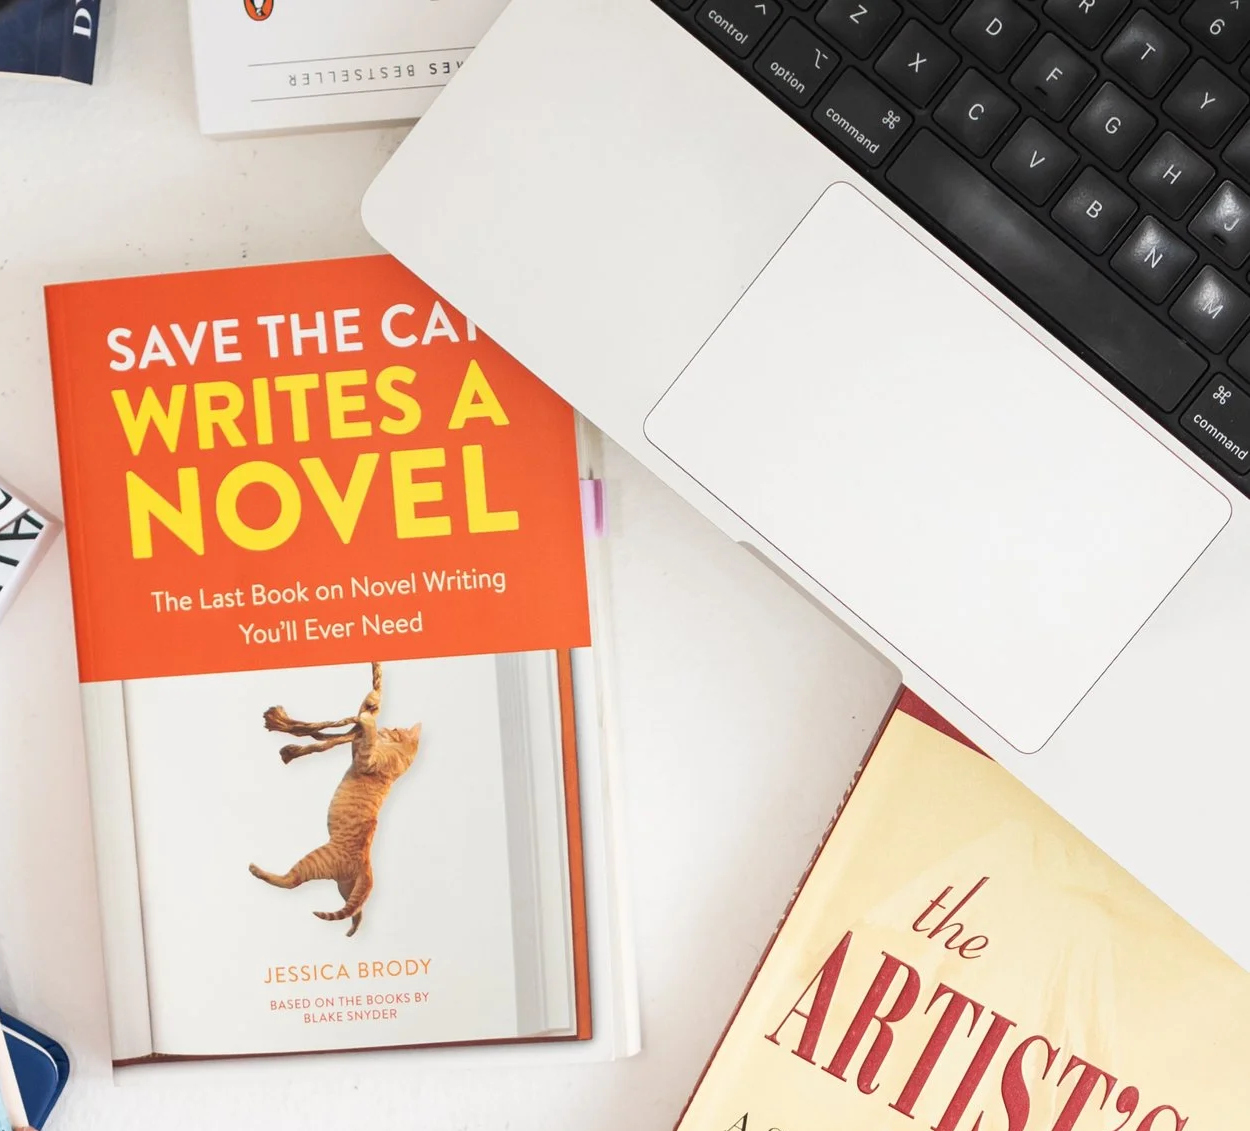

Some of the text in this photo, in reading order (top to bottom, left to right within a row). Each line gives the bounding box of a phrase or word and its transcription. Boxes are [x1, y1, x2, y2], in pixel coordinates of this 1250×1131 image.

[849, 4, 868, 25] Z
[708, 8, 749, 45] control
[985, 17, 1003, 36] D
[1209, 18, 1226, 35] 6
[1140, 42, 1156, 60] T
[907, 52, 928, 73] X
[288, 64, 415, 87] BESTSELLER
[770, 61, 806, 94] option
[1045, 66, 1063, 82] F
[1200, 91, 1216, 110] Y
[968, 103, 985, 121] C
[825, 107, 880, 155] command
[1104, 116, 1122, 135] G
[1029, 150, 1046, 169] V
[1162, 164, 1182, 185] H
[1086, 199, 1104, 221] B
[1144, 247, 1163, 269] N
[1201, 298, 1224, 320] M
[106, 318, 242, 372] SAVE
[258, 307, 364, 358] THE
[111, 359, 510, 457] WRITES A
[1193, 412, 1250, 461] command
[125, 444, 520, 560] NOVEL
[151, 567, 507, 614] The Last Book on Novel Writing
[238, 611, 423, 646] You'll Ever Need
[912, 875, 991, 960] the
[263, 958, 432, 984] JESSICA BRODY
[270, 991, 430, 1011] BASED ON THE BOOKS BY
[303, 1008, 398, 1024] BLAKE SNYDER
